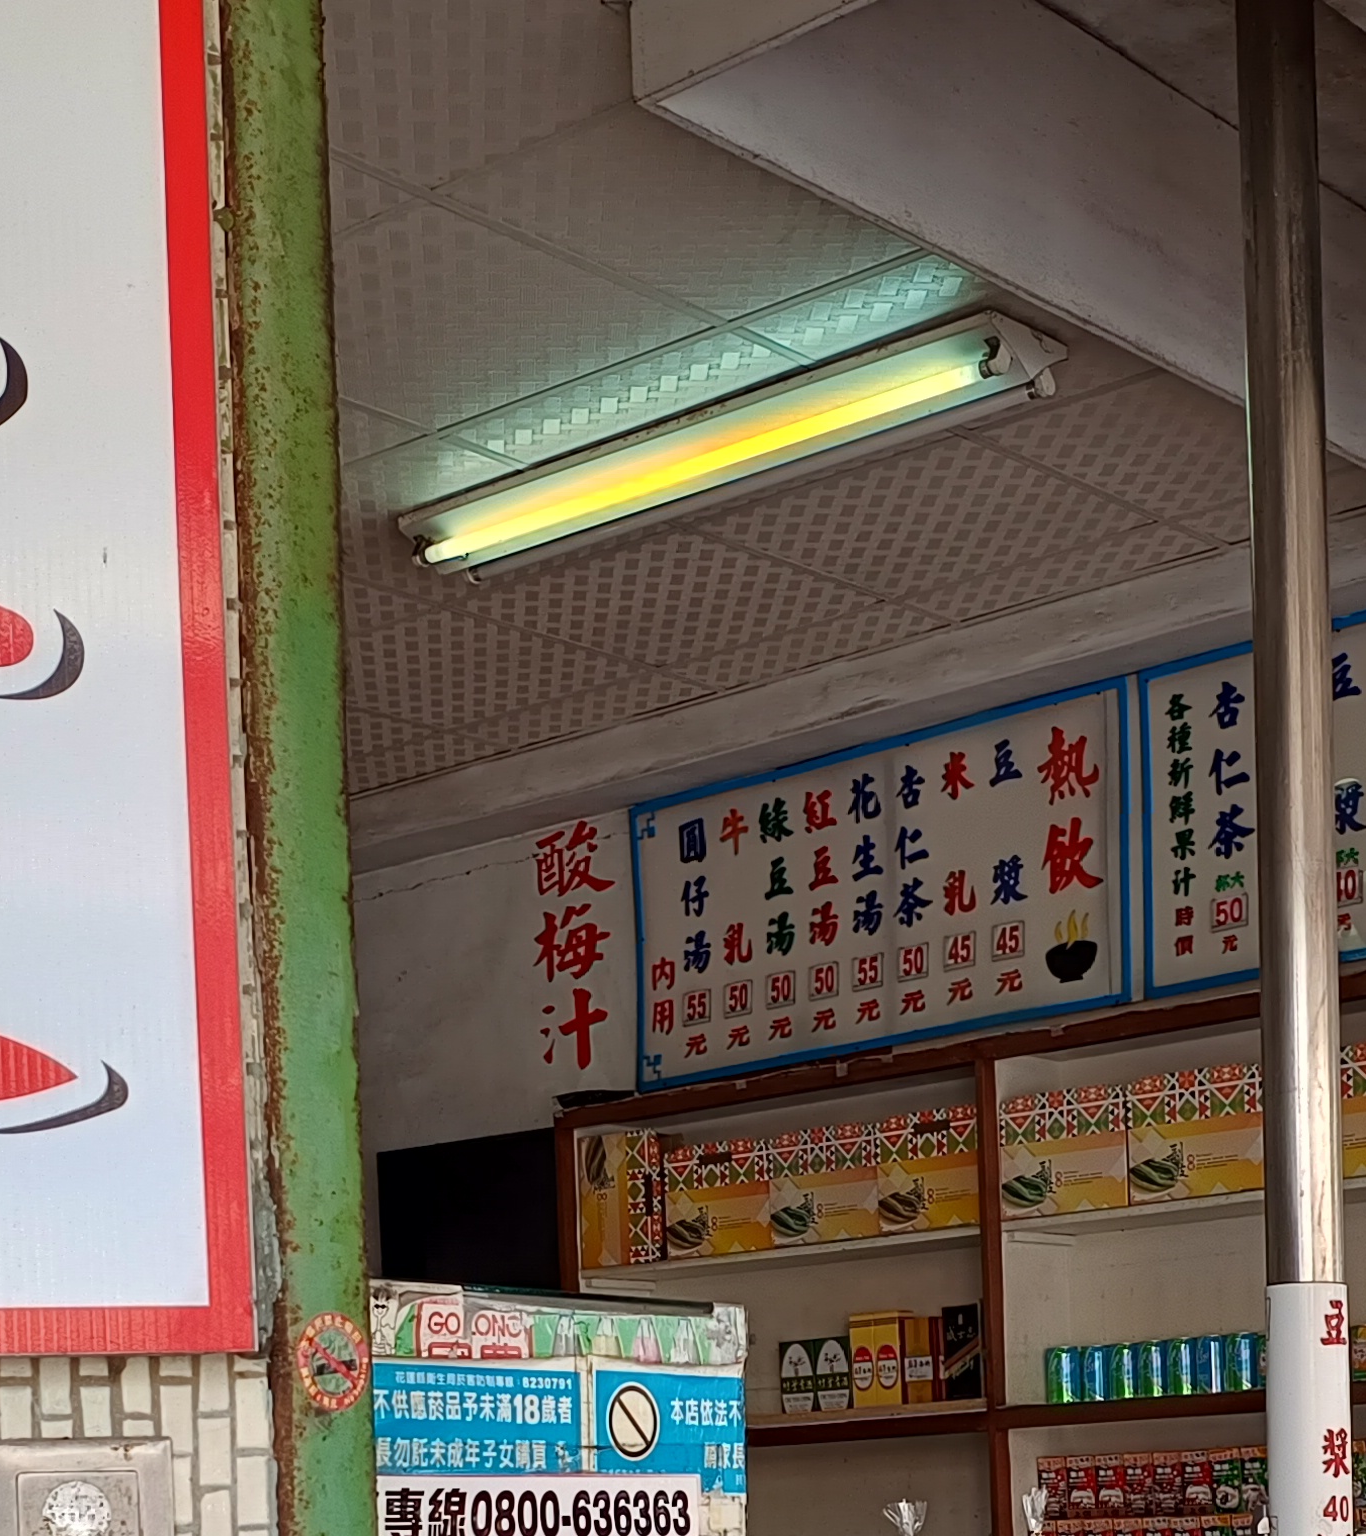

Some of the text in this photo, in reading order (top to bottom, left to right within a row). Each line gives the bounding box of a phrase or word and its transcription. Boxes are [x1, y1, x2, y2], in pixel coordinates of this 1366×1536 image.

[719, 808, 754, 1049] 牛乳 50 元
[758, 797, 795, 1041] 綠豆湯 50 元
[802, 790, 840, 1033] 紅豆湯 50 元
[847, 773, 884, 1024] 花生湯 55 元
[893, 765, 933, 1015] 杏仁茶 50 元
[941, 751, 976, 1004] 米乳 45 元
[988, 739, 1028, 995] 豆漿 45 元
[1037, 726, 1105, 895] 熱飲
[1164, 693, 1197, 956] 各種新鮮果汁 時價
[1208, 681, 1256, 955] 杏仁茶 50 元
[534, 820, 615, 1070] 酸梅汁
[651, 956, 676, 1034] 內用
[678, 817, 712, 1058] 圓仔湯 55 元
[374, 1388, 573, 1426] 不供應菸品予未滿18歲者
[427, 1311, 462, 1335] GO
[522, 1376, 573, 1390] 8230791
[1319, 1300, 1350, 1522] 豆漿 40
